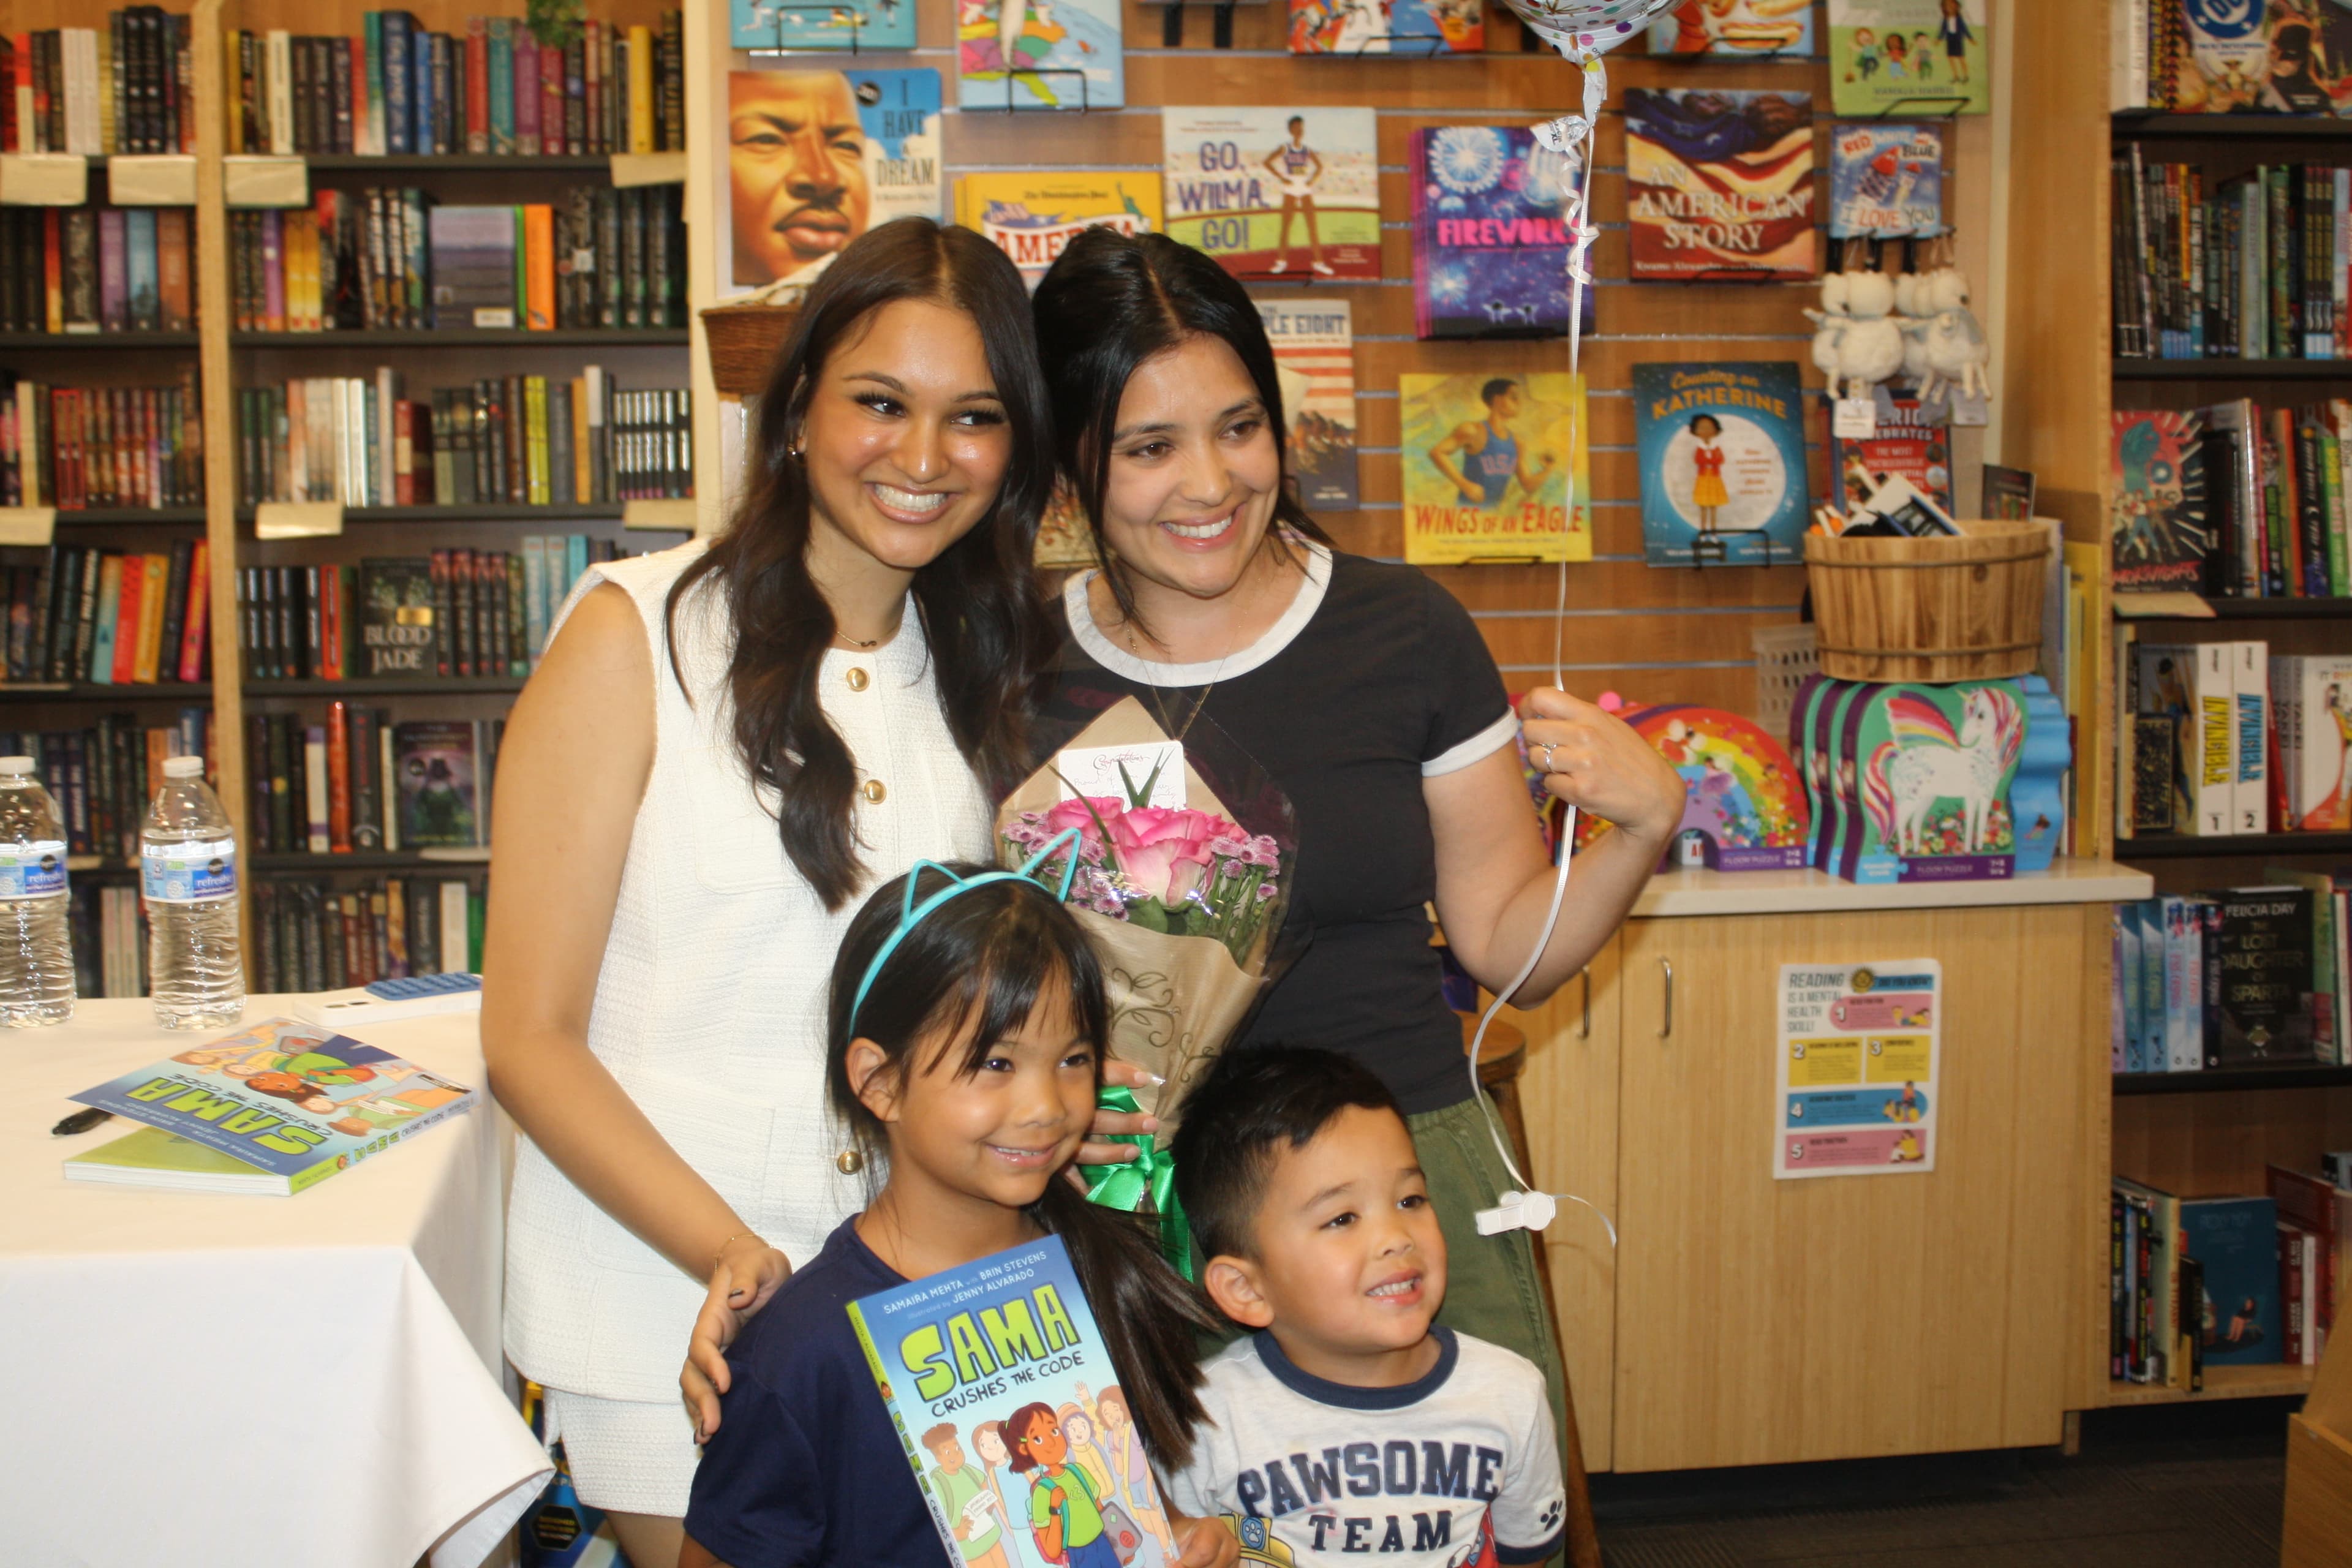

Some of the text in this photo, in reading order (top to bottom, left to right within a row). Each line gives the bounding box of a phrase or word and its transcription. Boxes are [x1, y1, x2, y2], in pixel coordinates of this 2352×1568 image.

[901, 78, 908, 107] I
[883, 110, 926, 138] HAVE
[1843, 135, 1872, 155] RED
[1902, 145, 1937, 159] BLUE
[877, 158, 934, 186] DREAM
[1649, 166, 1684, 186] AN
[1178, 178, 1270, 211] WILMA,
[1636, 191, 1806, 219] AMERICAN
[1858, 207, 1901, 228] LOVE
[1902, 205, 1936, 226] YOU
[995, 221, 1134, 263] AMEA
[1202, 217, 1250, 250] GO!
[1663, 223, 1765, 252] STORY
[1652, 386, 1787, 421] KATHERINE
[1414, 505, 1480, 535] WINGS
[1518, 501, 1584, 534] EAGLE
[363, 625, 432, 646] BLOOD
[371, 647, 422, 674] JADE
[2202, 696, 2231, 788] INVINCIBLE
[2237, 693, 2264, 784] INVINCIBLE
[2211, 816, 2219, 831] 1
[2245, 813, 2255, 828] 2
[2225, 902, 2297, 918] FELICIA DAY
[1789, 973, 1845, 989] READING
[1787, 992, 1796, 1004] IS
[1798, 992, 1804, 1003] A
[1807, 989, 1842, 1003] MENTAL
[1787, 1006, 1822, 1018] HEALTH
[1835, 1006, 1846, 1021] 1
[1792, 1043, 1806, 1059] 2
[1871, 1040, 1882, 1055] 3
[167, 1072, 223, 1092] CODE
[124, 1077, 329, 1156] SAMA
[252, 1101, 334, 1137] CRUSHES
[1790, 1102, 1803, 1118] 4
[1791, 1144, 1803, 1160] 5
[883, 1291, 930, 1315] SAMAIRA
[930, 1279, 964, 1298] MEHTA
[979, 1266, 1003, 1281] BRIN
[1003, 1251, 1047, 1273] STEVENS
[952, 1286, 984, 1305] JENNY
[987, 1268, 1035, 1292] ALVARADO
[899, 1282, 1082, 1404] SAMA
[930, 1350, 1085, 1419] CRUSHES THE CODE
[892, 1410, 932, 1496] SAMA
[1237, 1439, 1504, 1518] PAWSOME
[929, 1499, 950, 1540] CRUSHES
[948, 1540, 957, 1555] THE
[1308, 1509, 1453, 1553] TEAM
